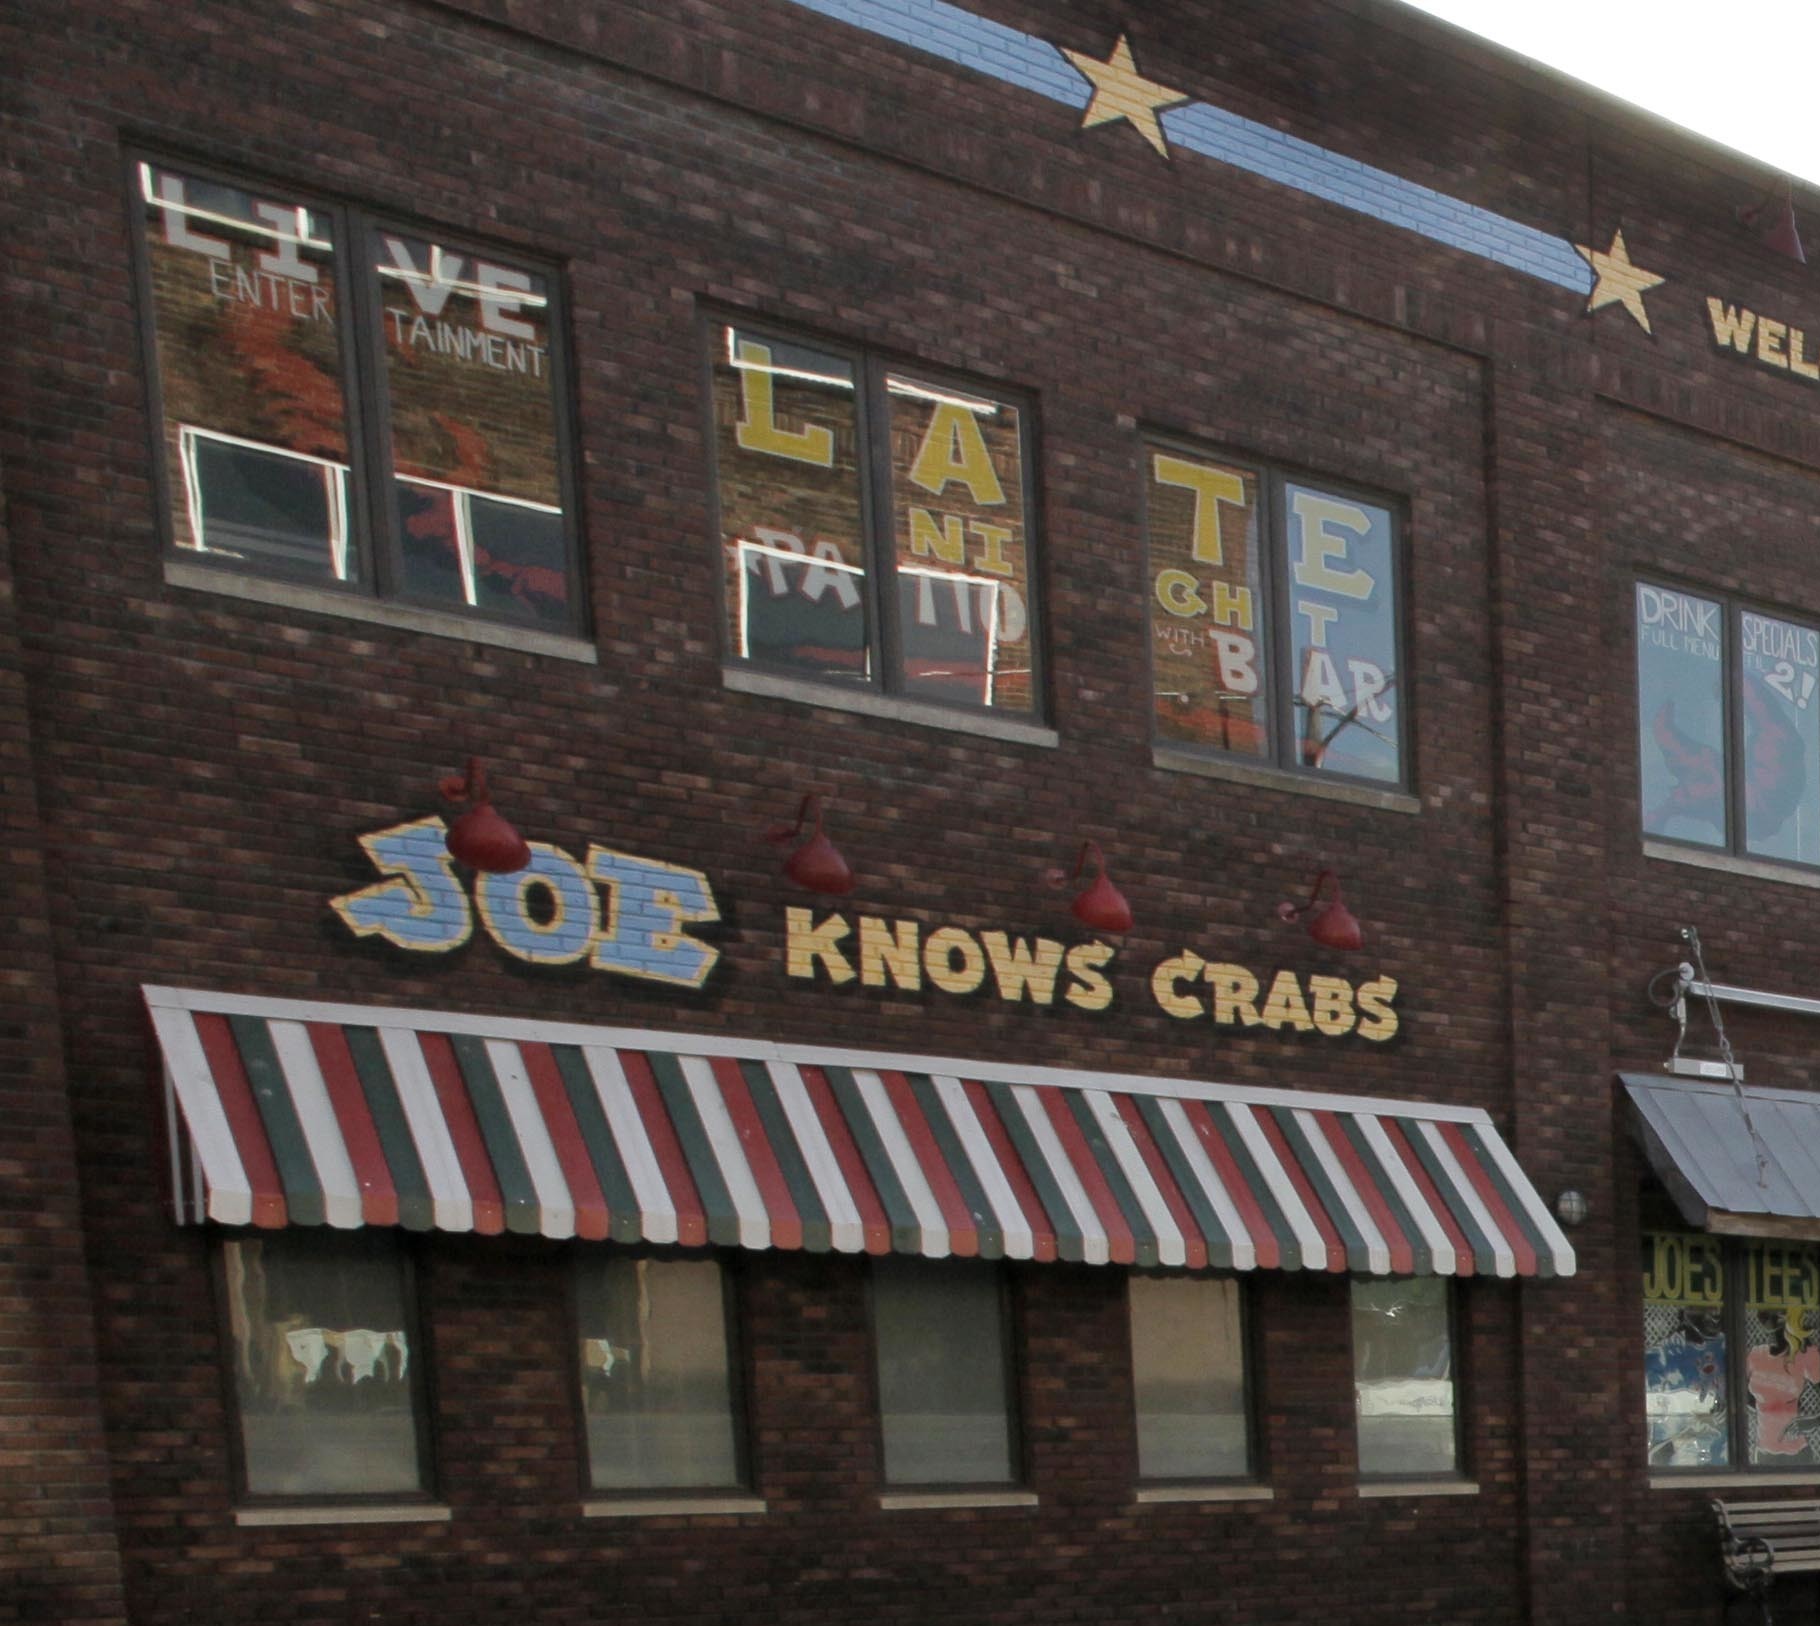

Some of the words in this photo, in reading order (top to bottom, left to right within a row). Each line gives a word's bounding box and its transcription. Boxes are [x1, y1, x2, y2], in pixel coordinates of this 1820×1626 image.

[1639, 586, 1720, 642] DRINK
[1742, 614, 1818, 667] SPECIALS
[1641, 628, 1678, 650] FULL
[1684, 636, 1720, 661] MENU
[328, 814, 722, 990] JOE
[786, 906, 1118, 1011] KNOWS
[1150, 948, 1400, 1042] CRABS
[1643, 1232, 1723, 1301] JOES
